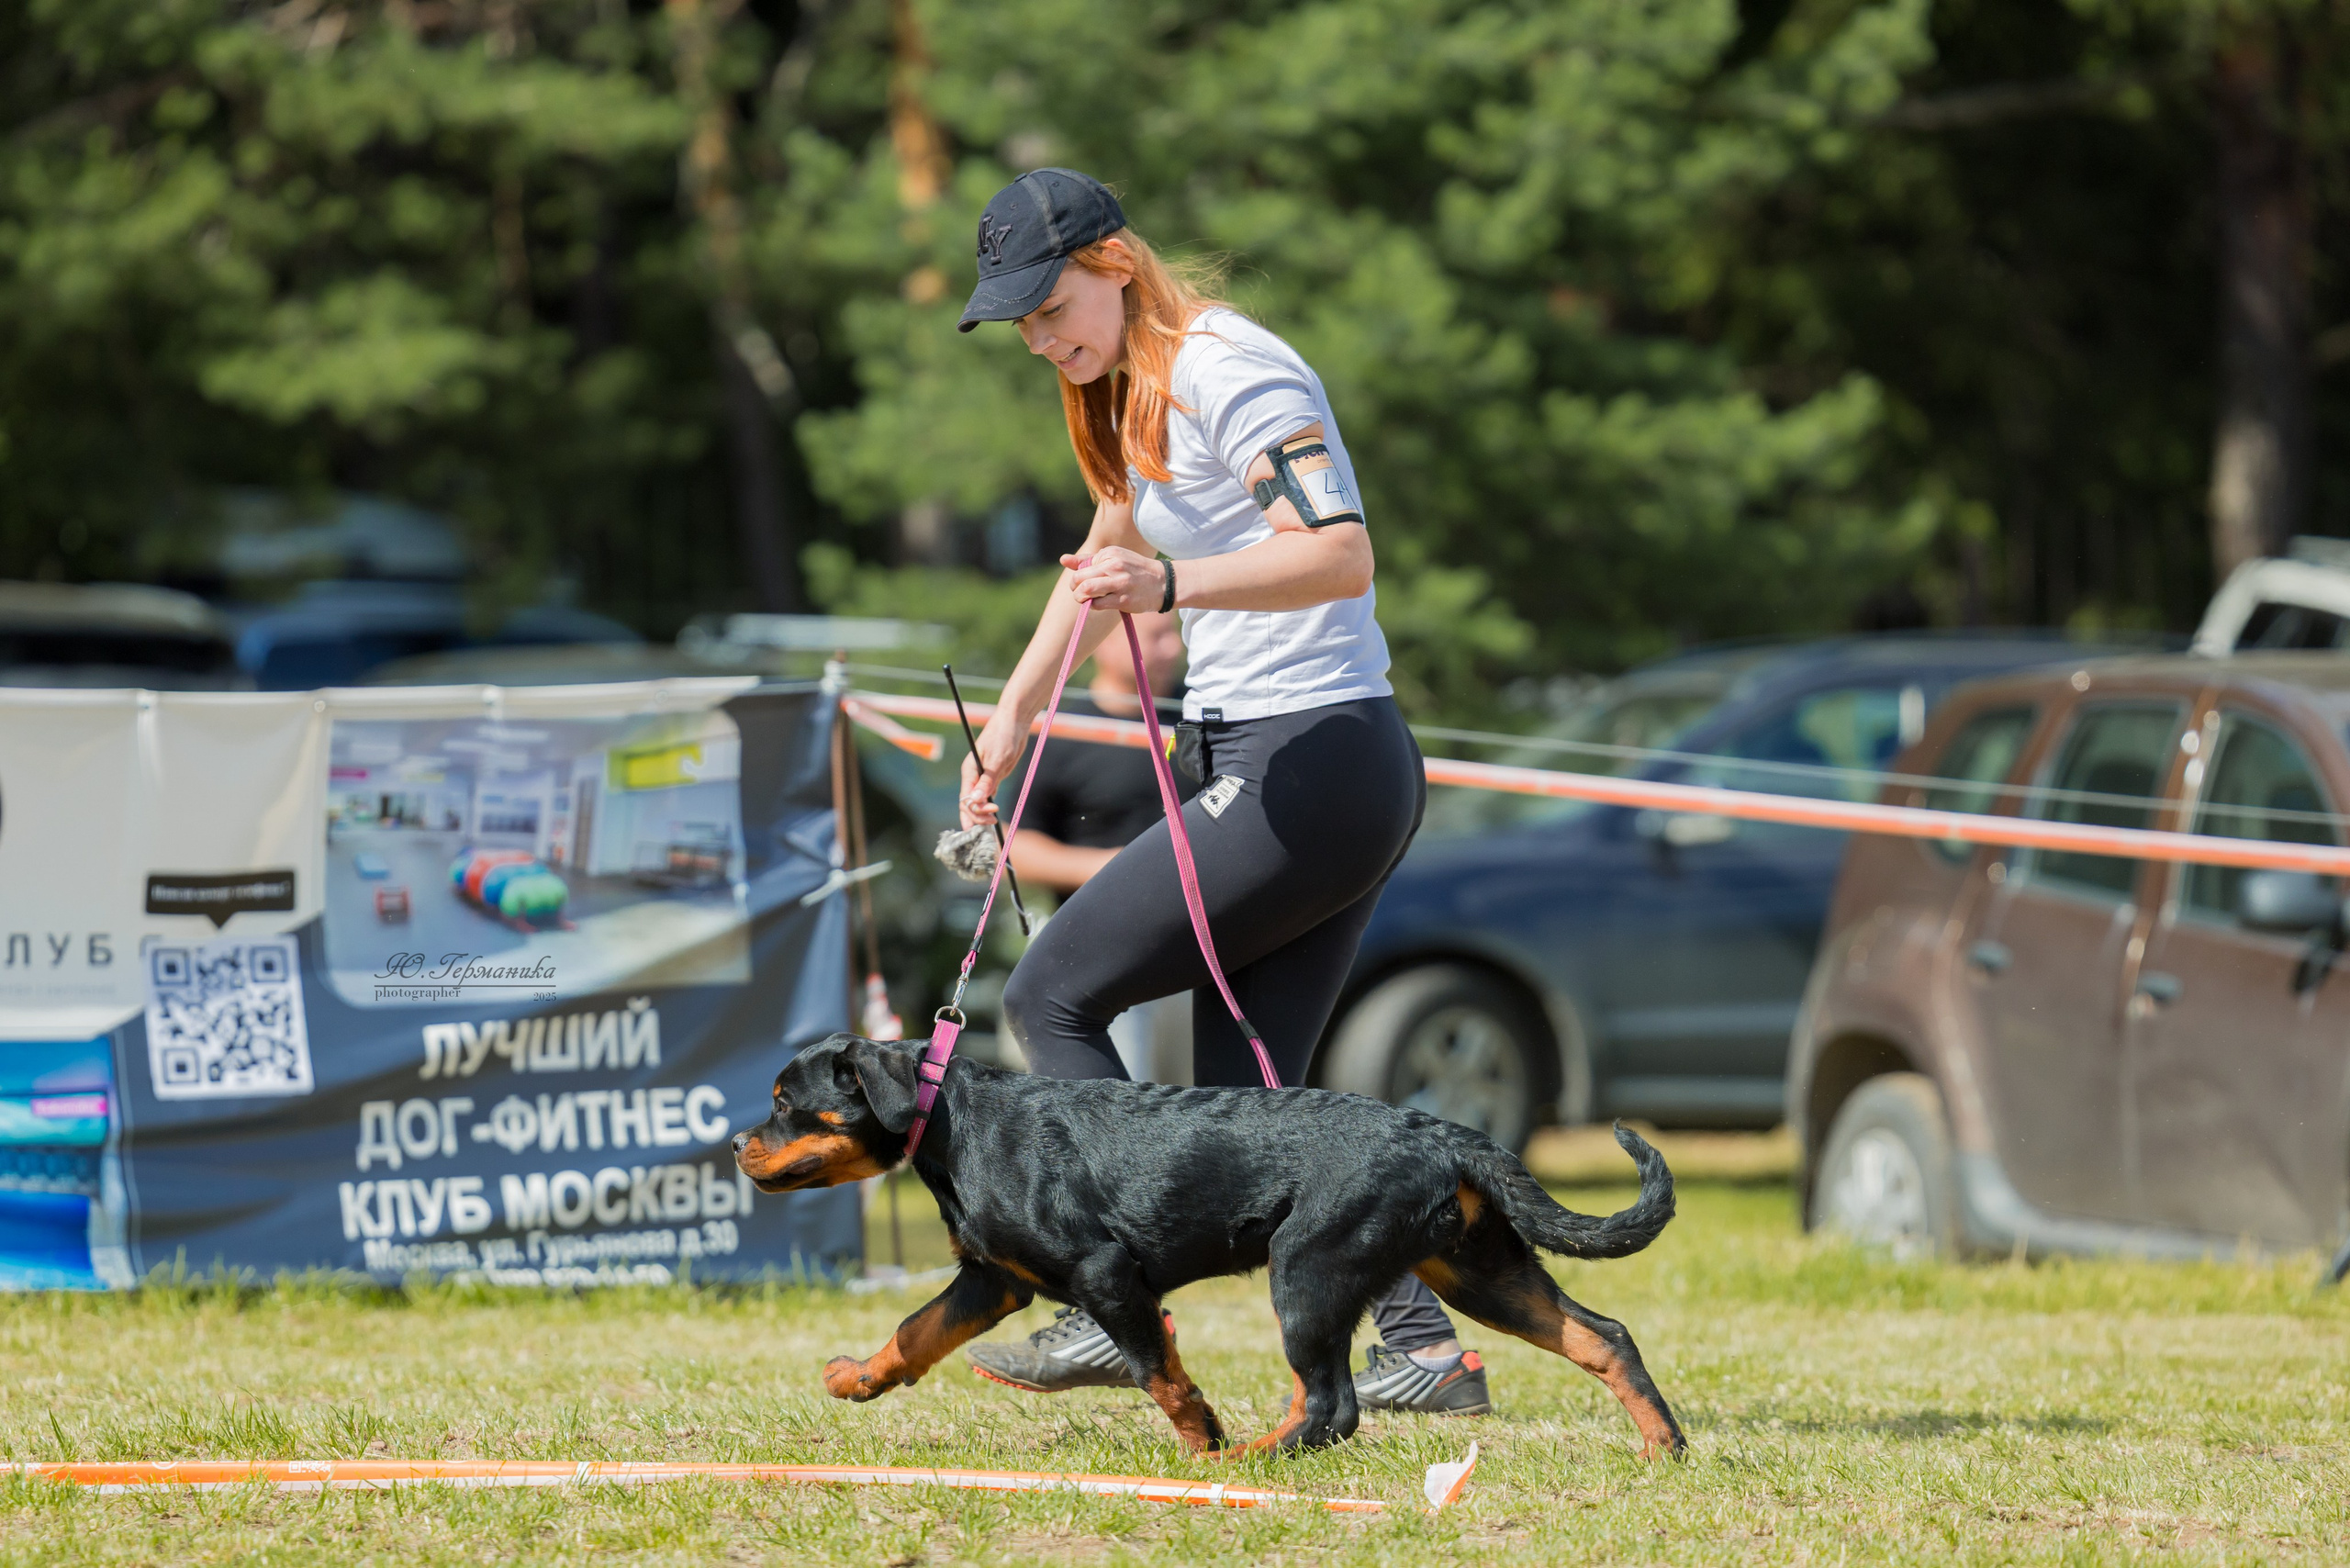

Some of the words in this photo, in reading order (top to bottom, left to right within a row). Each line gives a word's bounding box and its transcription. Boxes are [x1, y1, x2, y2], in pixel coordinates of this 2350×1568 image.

[419, 996, 662, 1081] ЛУЧШИЙ
[356, 1085, 731, 1171] ДОГ-ФИТНЕС
[339, 1176, 493, 1240] КЛУБ
[499, 1160, 755, 1230] МОСКВЫ
